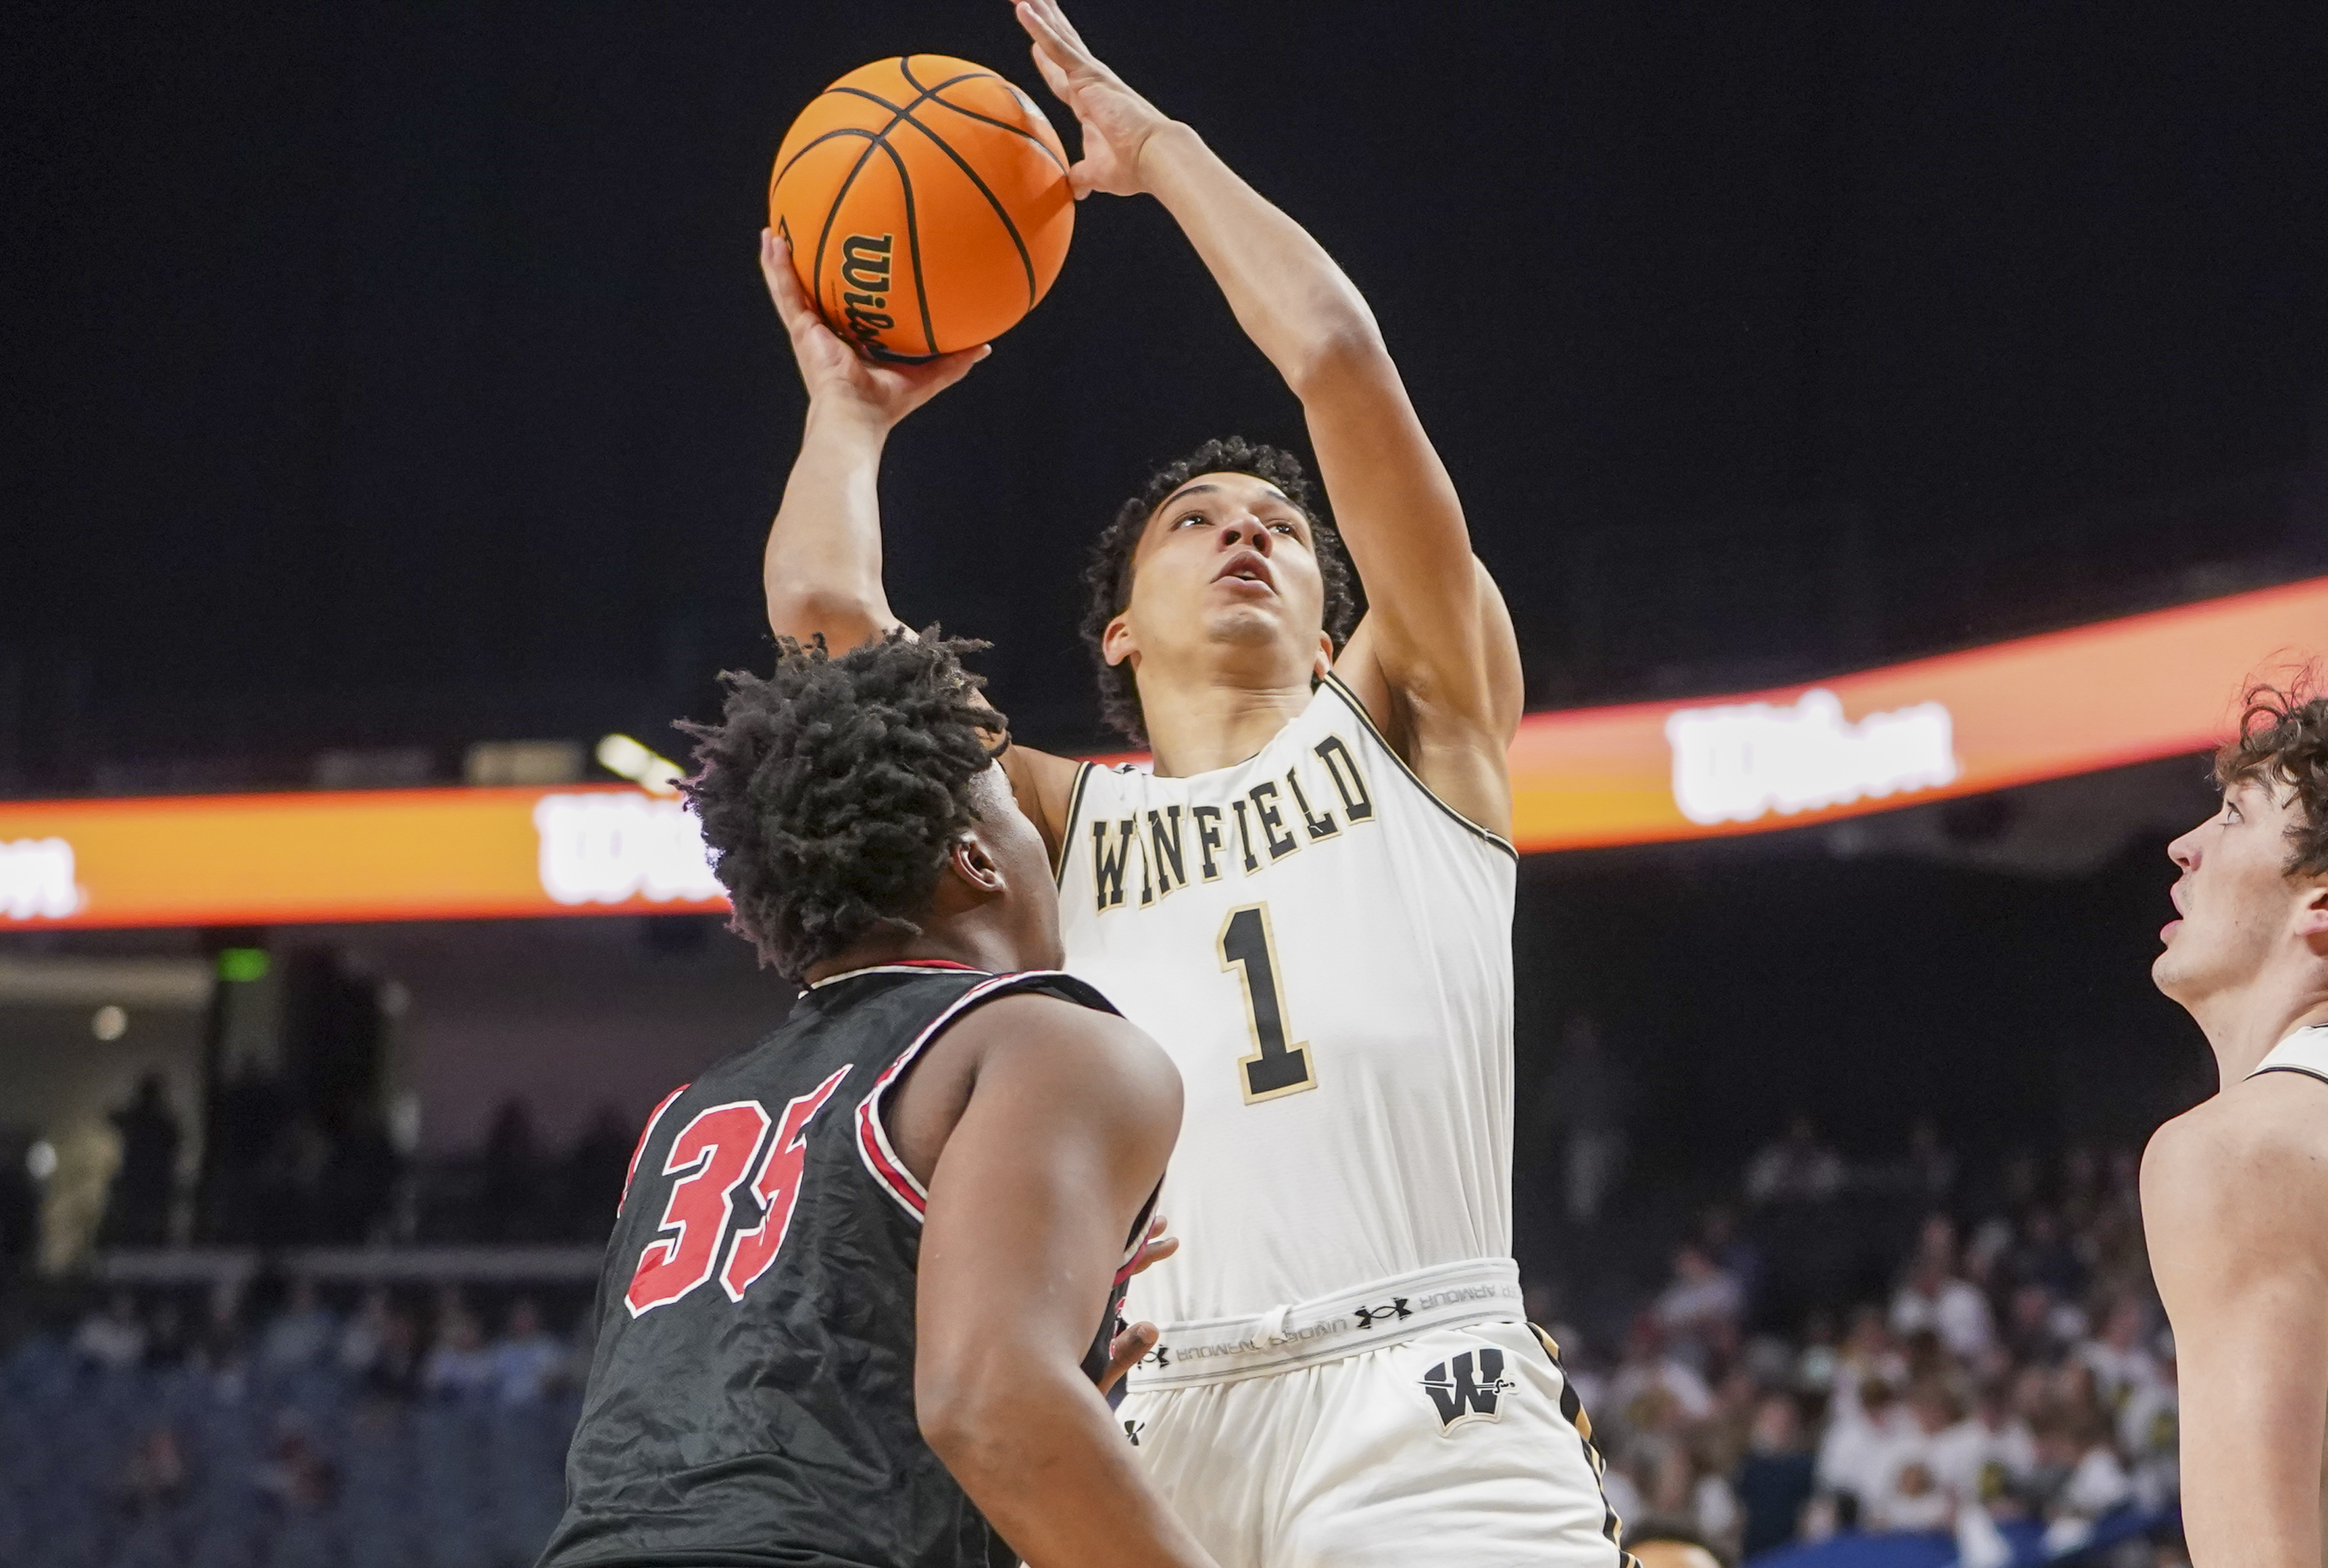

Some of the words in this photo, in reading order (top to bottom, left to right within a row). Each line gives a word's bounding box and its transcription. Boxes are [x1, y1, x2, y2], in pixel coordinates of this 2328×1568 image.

[1089, 732, 1375, 917] WINFIELD
[1218, 901, 1318, 1106] 1
[624, 1063, 854, 1319] 35
